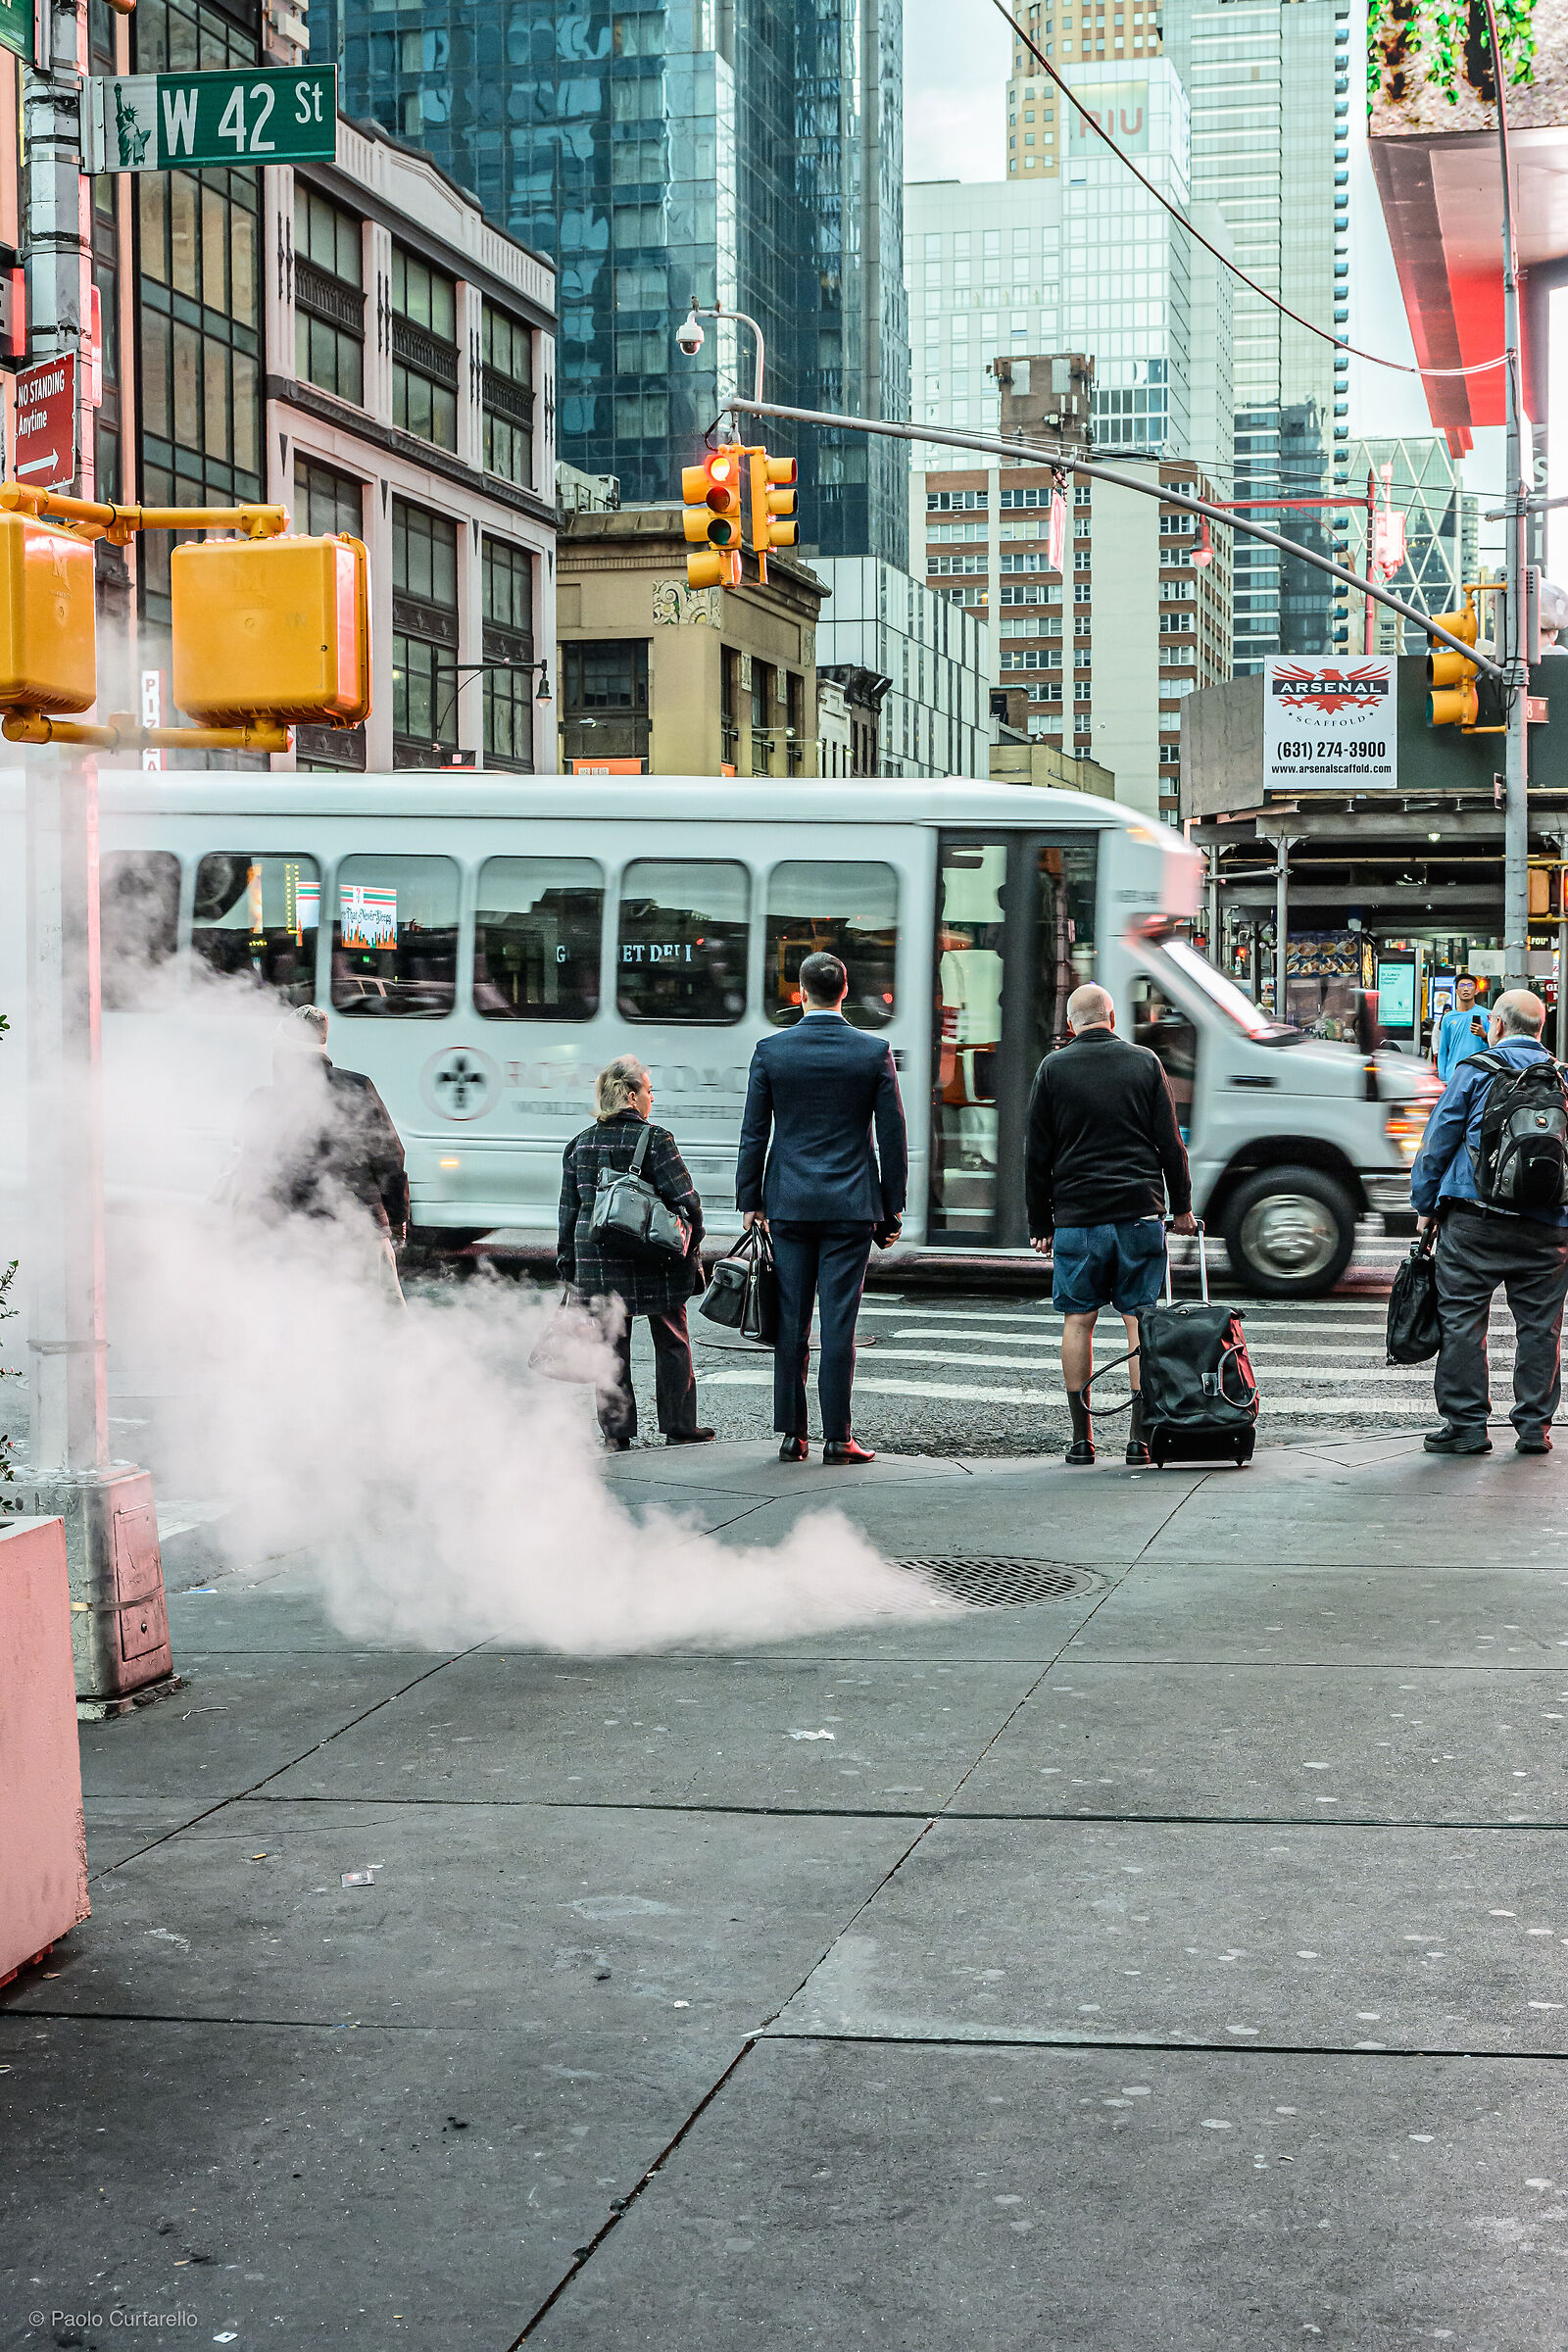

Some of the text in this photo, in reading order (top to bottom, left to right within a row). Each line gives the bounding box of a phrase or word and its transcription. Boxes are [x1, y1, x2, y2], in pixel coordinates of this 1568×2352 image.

[162, 80, 323, 156] W 42 St
[1080, 107, 1143, 138] RIU
[18, 368, 66, 408] NO STANDING
[18, 409, 48, 439] Anytime
[1280, 682, 1382, 693] ARSENAL
[1296, 715, 1366, 727] SCAFFOLD
[1277, 742, 1386, 760] (631) 274-3900
[1271, 763, 1392, 774] www.arsenalscaffold.com
